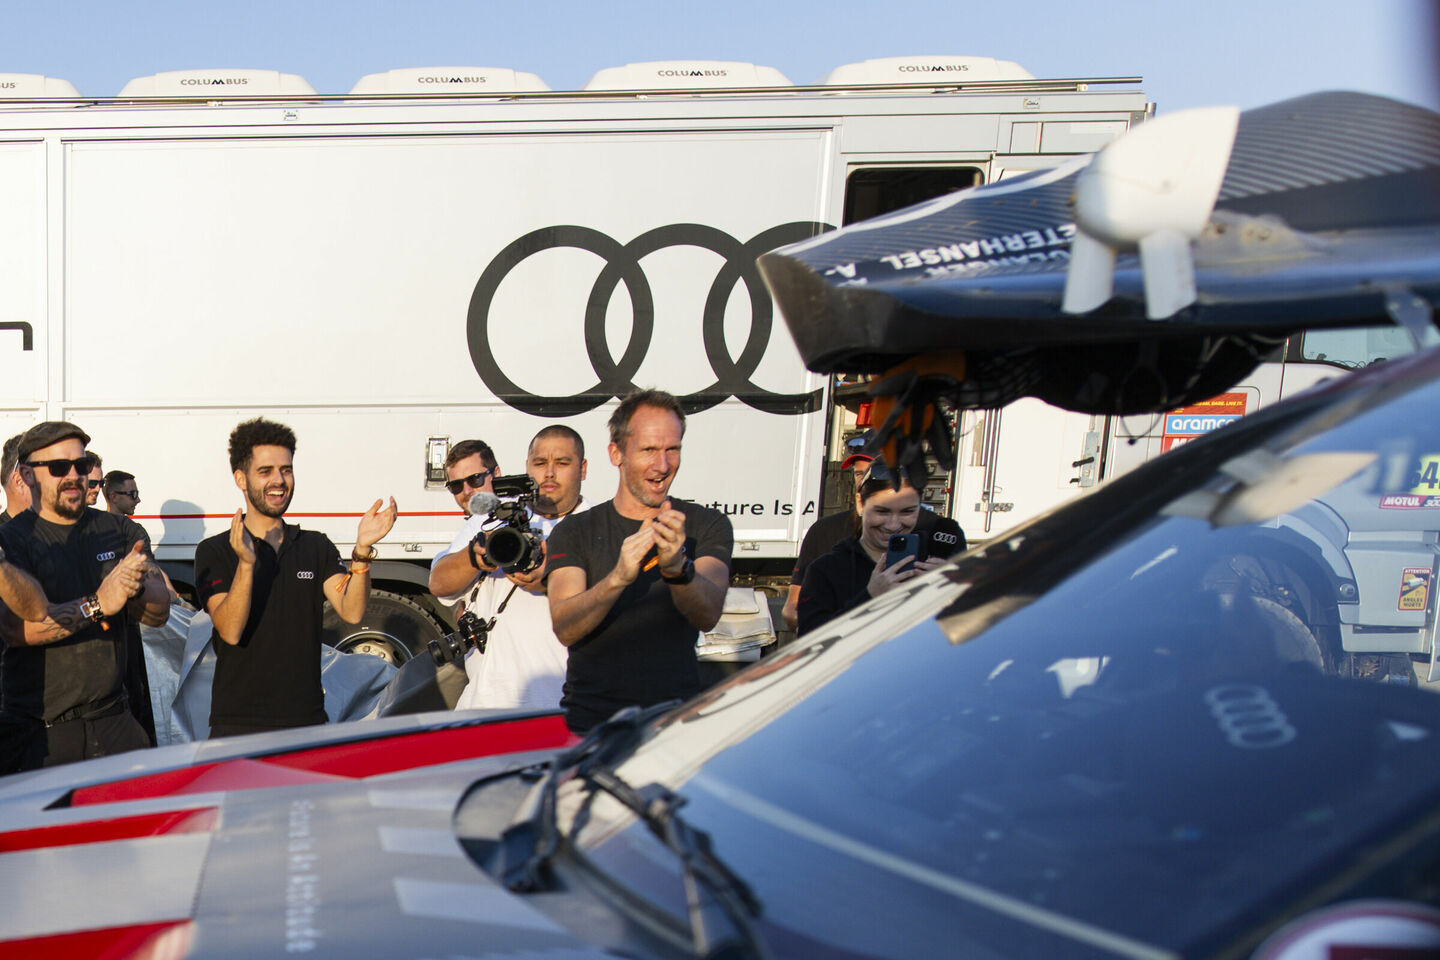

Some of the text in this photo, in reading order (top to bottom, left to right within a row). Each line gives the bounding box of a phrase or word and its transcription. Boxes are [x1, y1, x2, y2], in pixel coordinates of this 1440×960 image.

[898, 65, 969, 73] COLUMBUS
[180, 78, 249, 86] COLUMBUS
[417, 76, 487, 84] COLUMBUS
[880, 223, 1077, 270] ETERHANSEL
[1384, 496, 1420, 506] MOTUL
[774, 499, 793, 516] Is
